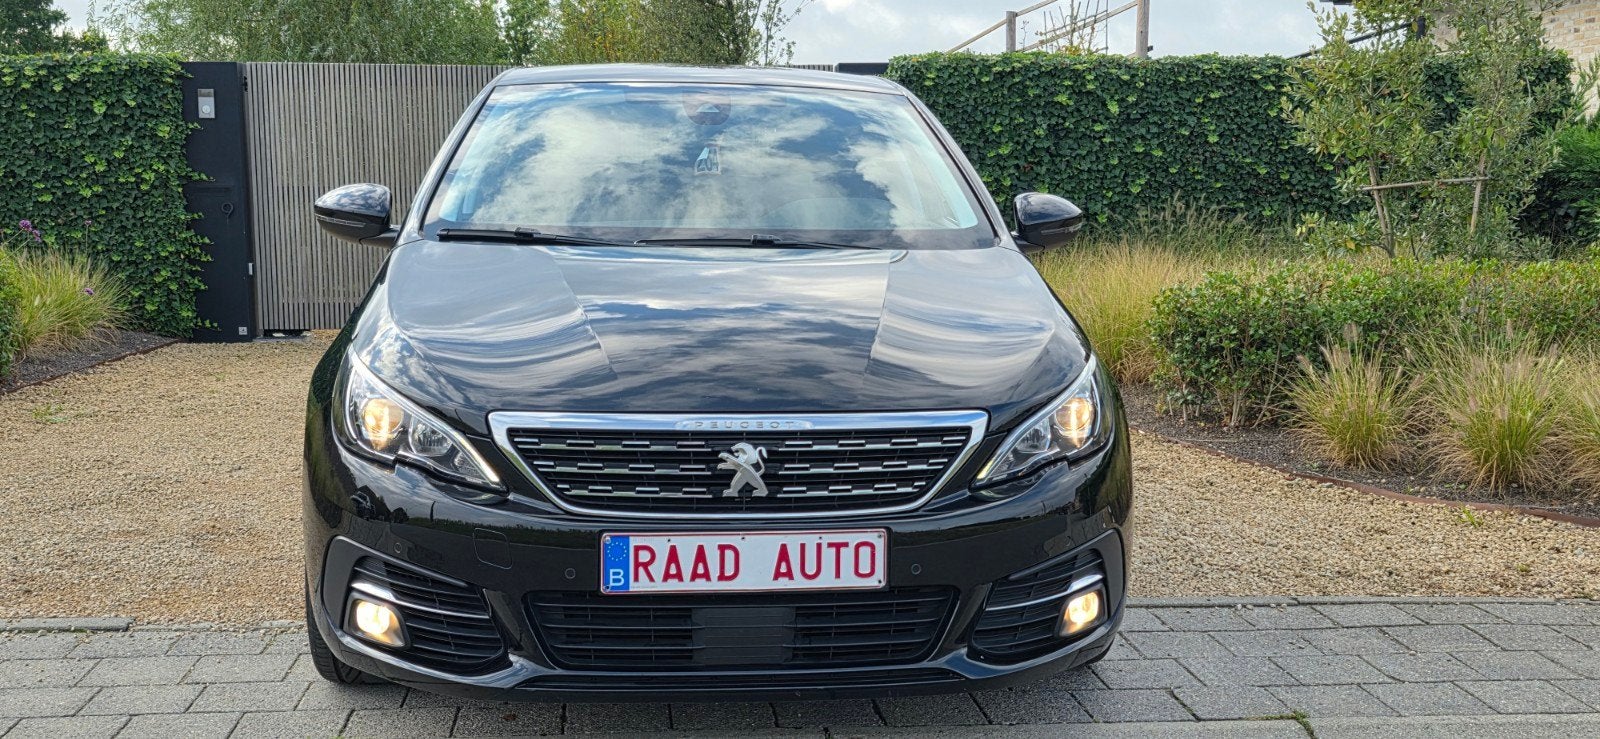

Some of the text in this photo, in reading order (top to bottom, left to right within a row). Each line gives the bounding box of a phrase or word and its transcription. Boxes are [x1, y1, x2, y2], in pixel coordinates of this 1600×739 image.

[695, 421, 794, 429] PEUGEOT
[633, 541, 876, 583] RAAD AUTO
[609, 569, 625, 587] B
